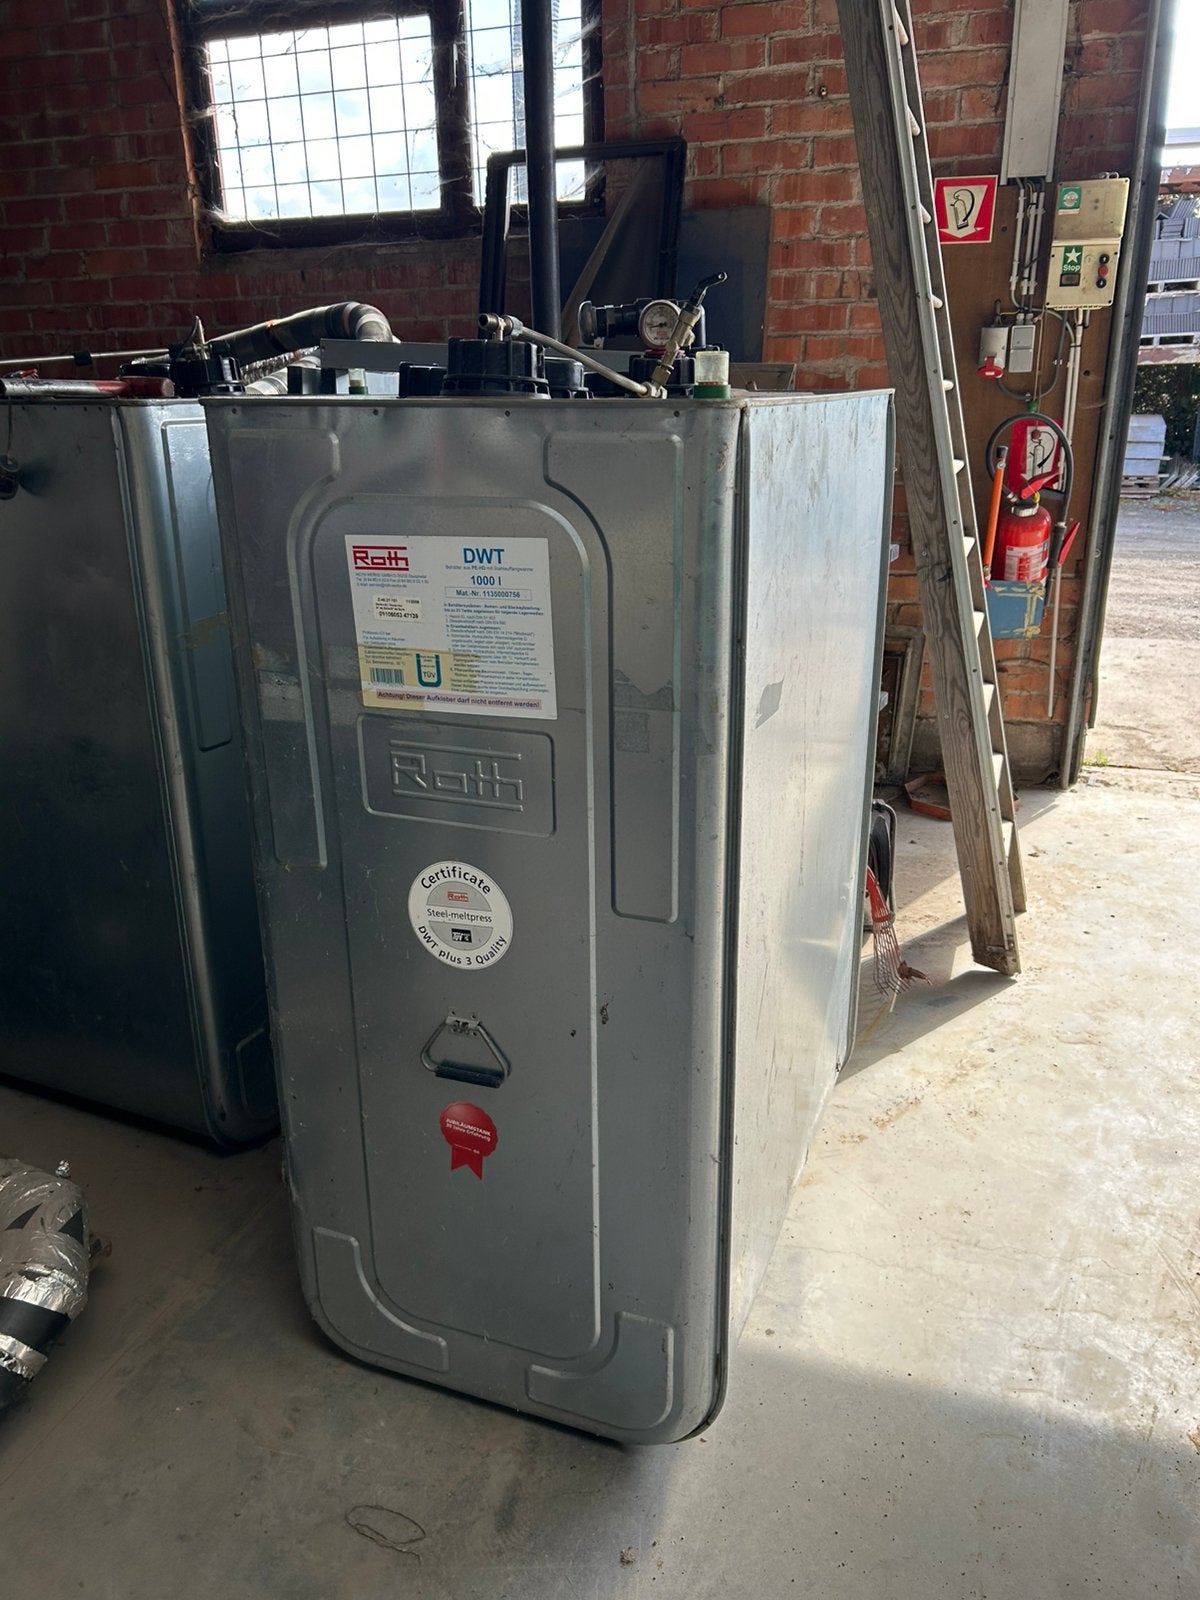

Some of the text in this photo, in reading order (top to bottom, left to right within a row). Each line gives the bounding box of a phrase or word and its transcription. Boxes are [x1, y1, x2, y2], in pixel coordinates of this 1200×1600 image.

[1063, 264, 1080, 272] Stop
[353, 549, 409, 567] Roth
[463, 548, 505, 564] DWT
[471, 576, 495, 585] 1000
[426, 694, 454, 702] Aufkleber
[390, 750, 523, 801] Roth
[421, 866, 491, 894] Certificate
[427, 908, 492, 923] Steel-meltpress
[418, 926, 439, 949] DWT
[439, 950, 462, 964] plus
[466, 957, 472, 965] 3
[476, 935, 507, 965] Quality
